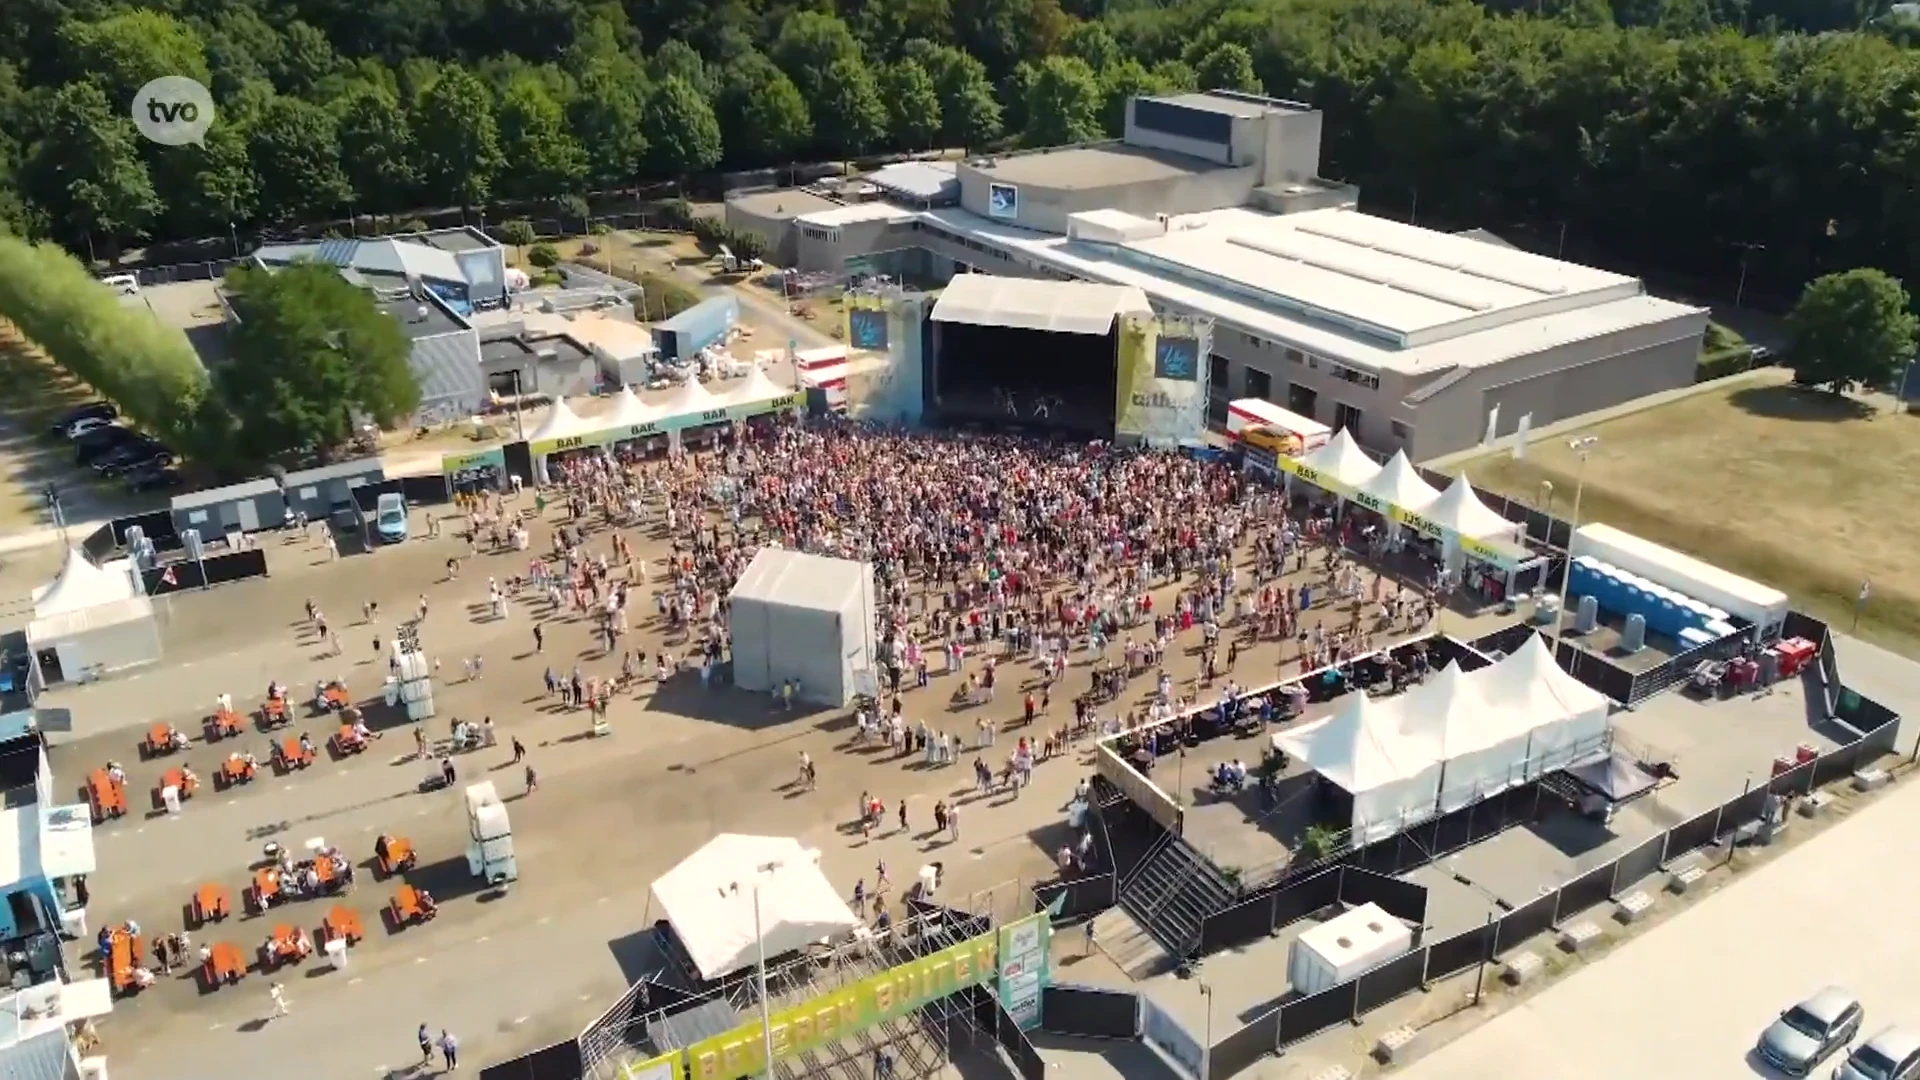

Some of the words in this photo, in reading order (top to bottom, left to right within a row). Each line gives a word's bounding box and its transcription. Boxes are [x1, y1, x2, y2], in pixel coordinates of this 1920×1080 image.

[771, 395, 796, 408] BAR
[703, 408, 728, 421] BAR
[630, 422, 656, 436] BAR
[556, 435, 583, 449] BAR
[1296, 464, 1318, 482] BAR
[1356, 492, 1380, 510] BAR
[876, 943, 996, 1012] BUITEN
